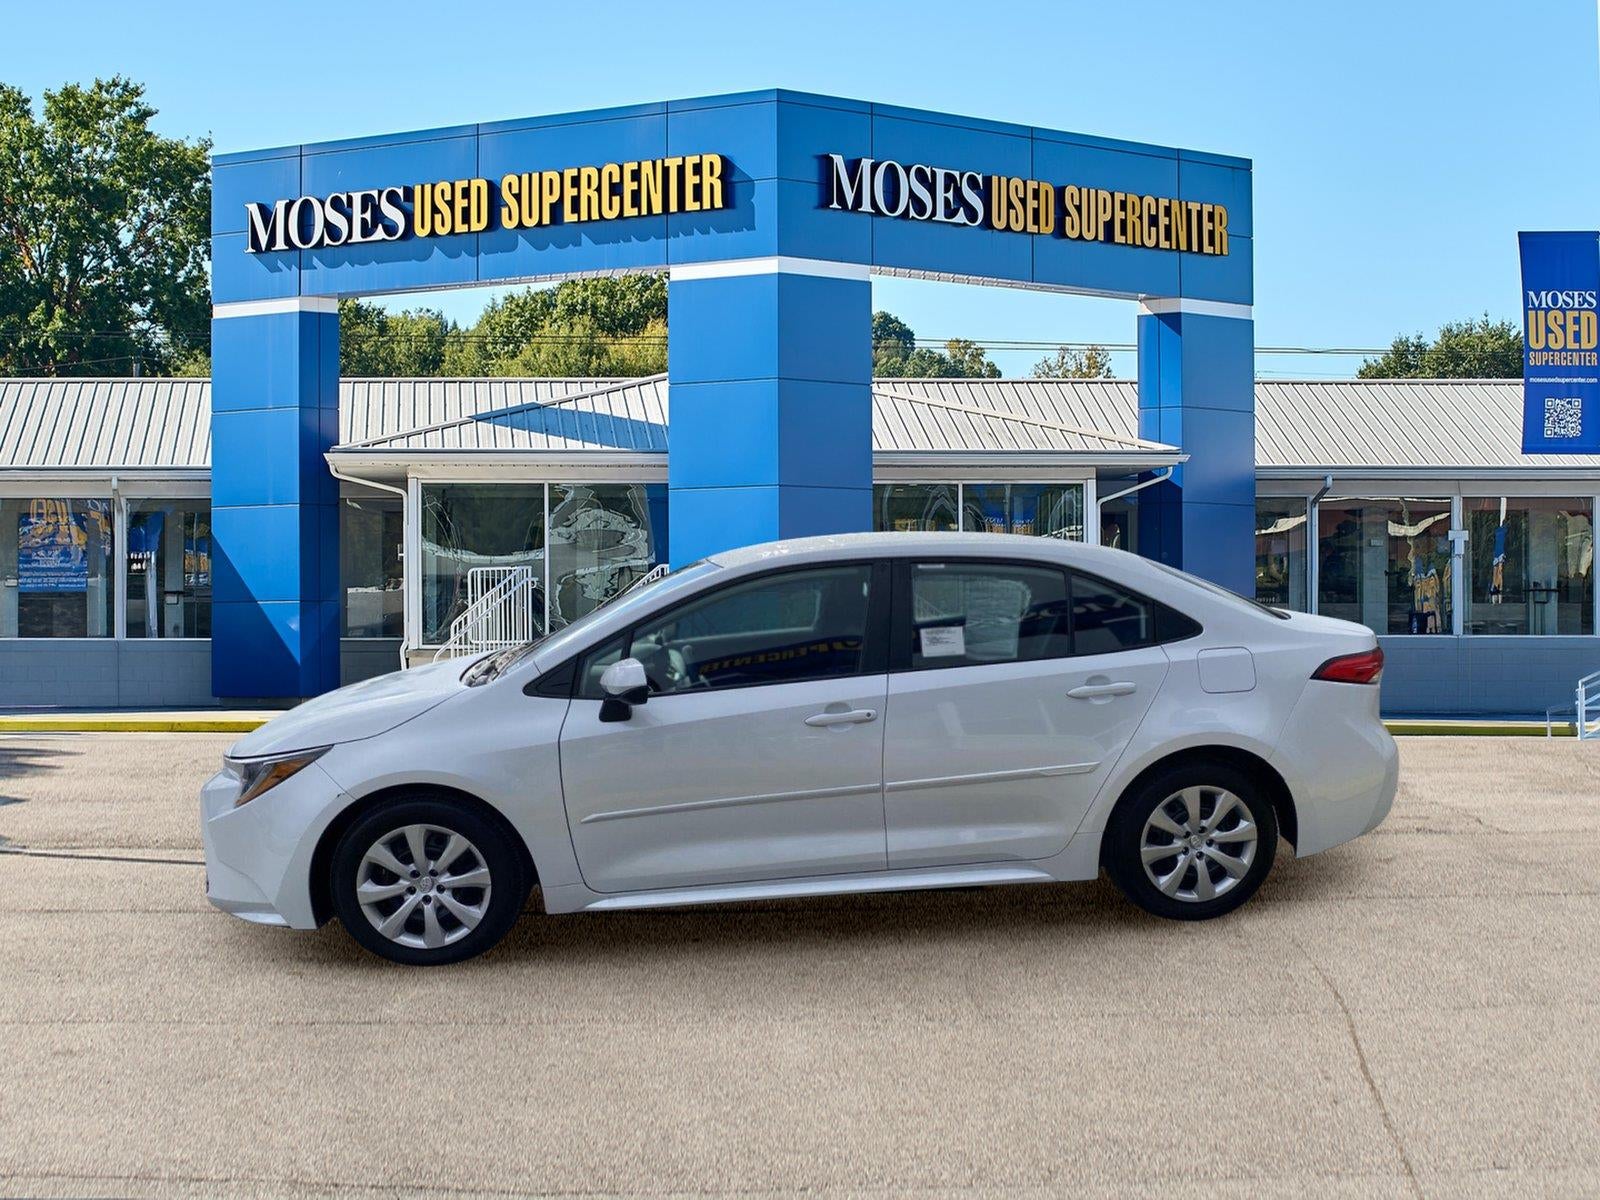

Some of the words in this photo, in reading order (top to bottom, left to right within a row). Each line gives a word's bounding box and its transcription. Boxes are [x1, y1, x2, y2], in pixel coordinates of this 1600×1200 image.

[243, 186, 406, 254] MOSES
[413, 178, 489, 238] USED
[500, 153, 724, 230] SUPERCENTER
[827, 153, 984, 227] MOSES
[990, 175, 1056, 235] USED
[1064, 184, 1230, 256] SUPERCENTER
[1527, 290, 1597, 309] MOSES
[1528, 310, 1598, 350] USED
[1529, 351, 1598, 366] SUPERCENTER
